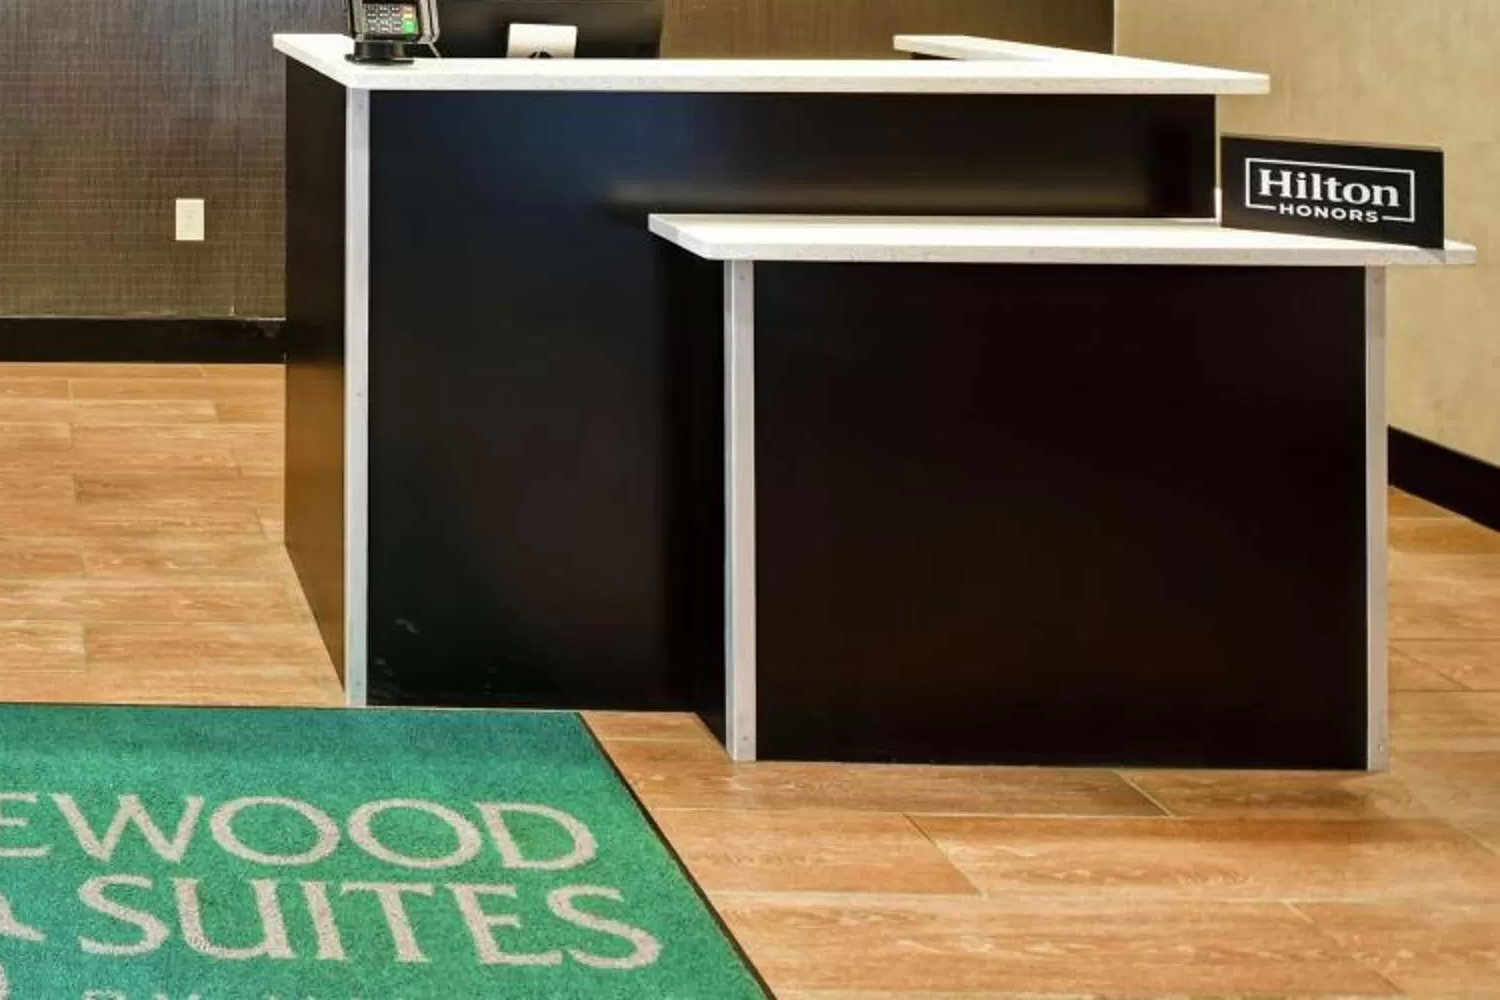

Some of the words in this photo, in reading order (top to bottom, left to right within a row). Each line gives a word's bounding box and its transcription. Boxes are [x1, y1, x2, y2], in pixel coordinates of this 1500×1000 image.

[1258, 168, 1400, 208] Hilton
[1279, 203, 1379, 224] HONORS
[76, 874, 663, 970] SUITES
